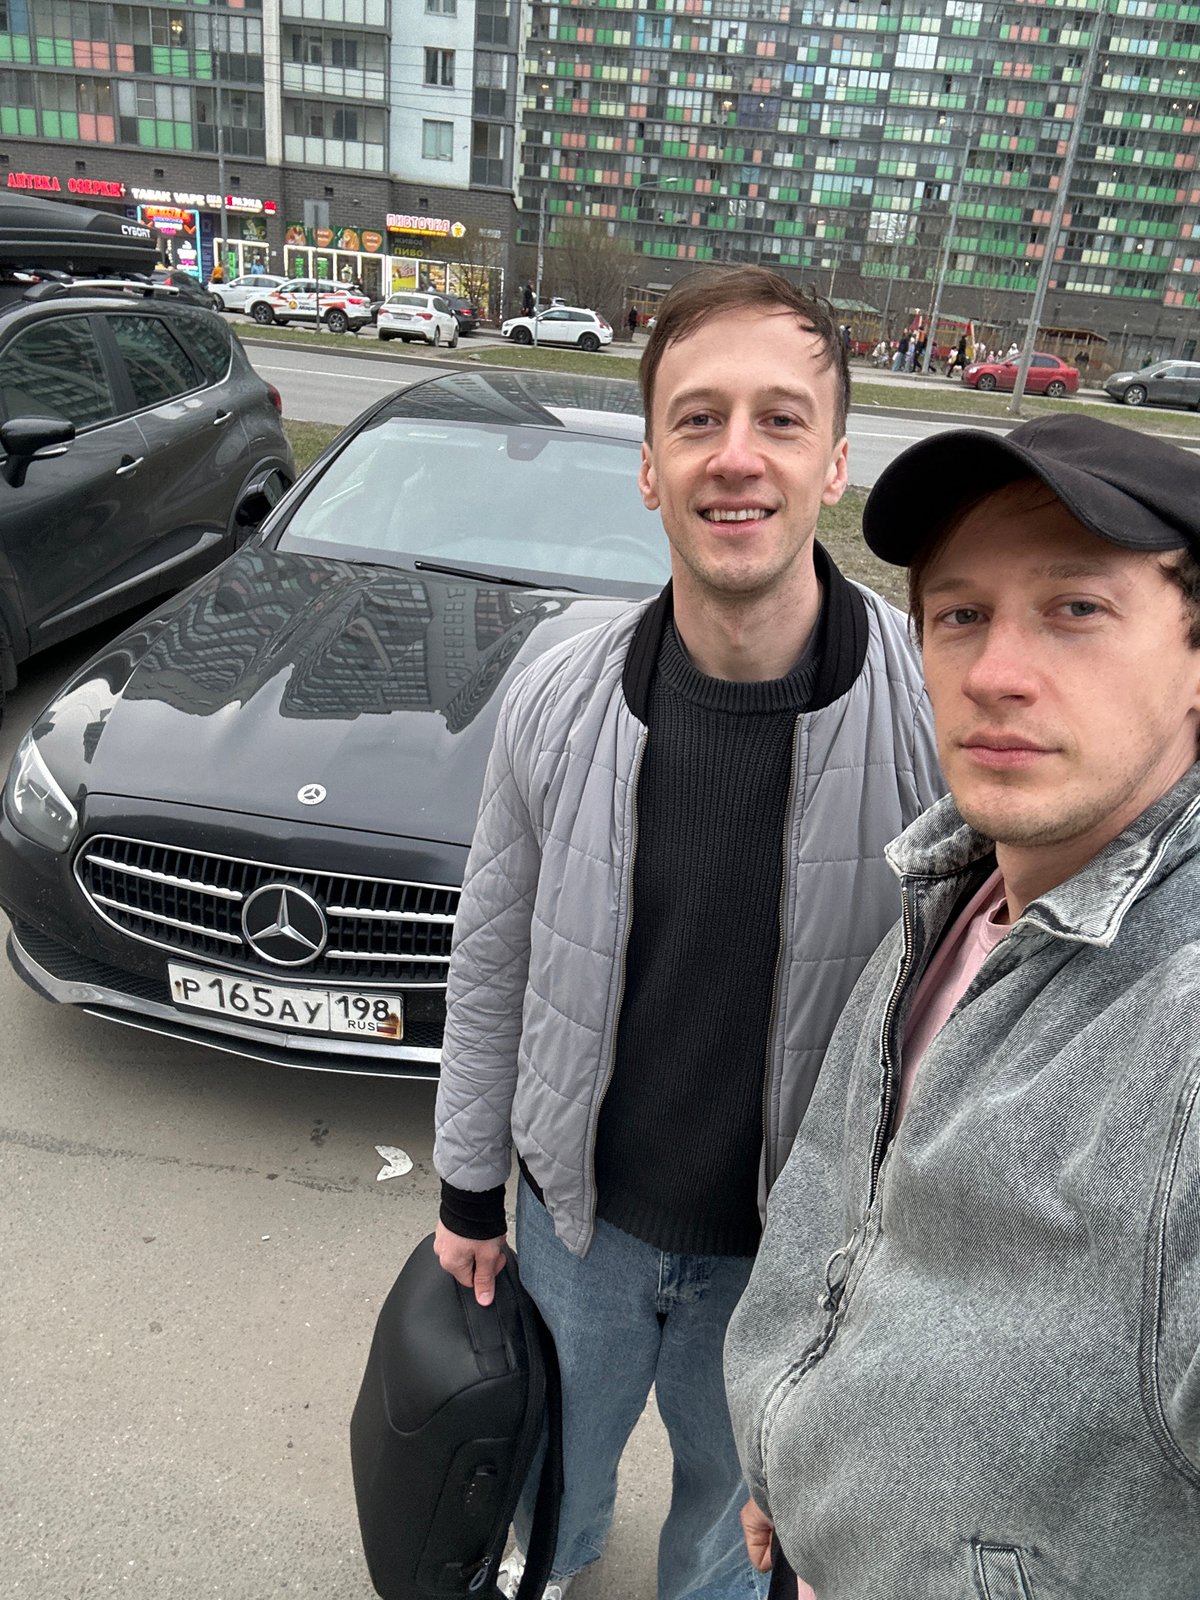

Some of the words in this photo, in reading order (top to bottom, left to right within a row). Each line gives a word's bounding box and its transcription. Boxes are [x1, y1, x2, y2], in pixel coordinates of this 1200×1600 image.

[7, 172, 61, 191] АПТЕКА
[68, 178, 121, 197] ОЗЕРКИ
[131, 188, 171, 202] ТАБАК
[173, 191, 205, 206] VAPE
[394, 247, 424, 257] ПИВО
[335, 995, 390, 1021] 198
[348, 1019, 376, 1031] RUS
